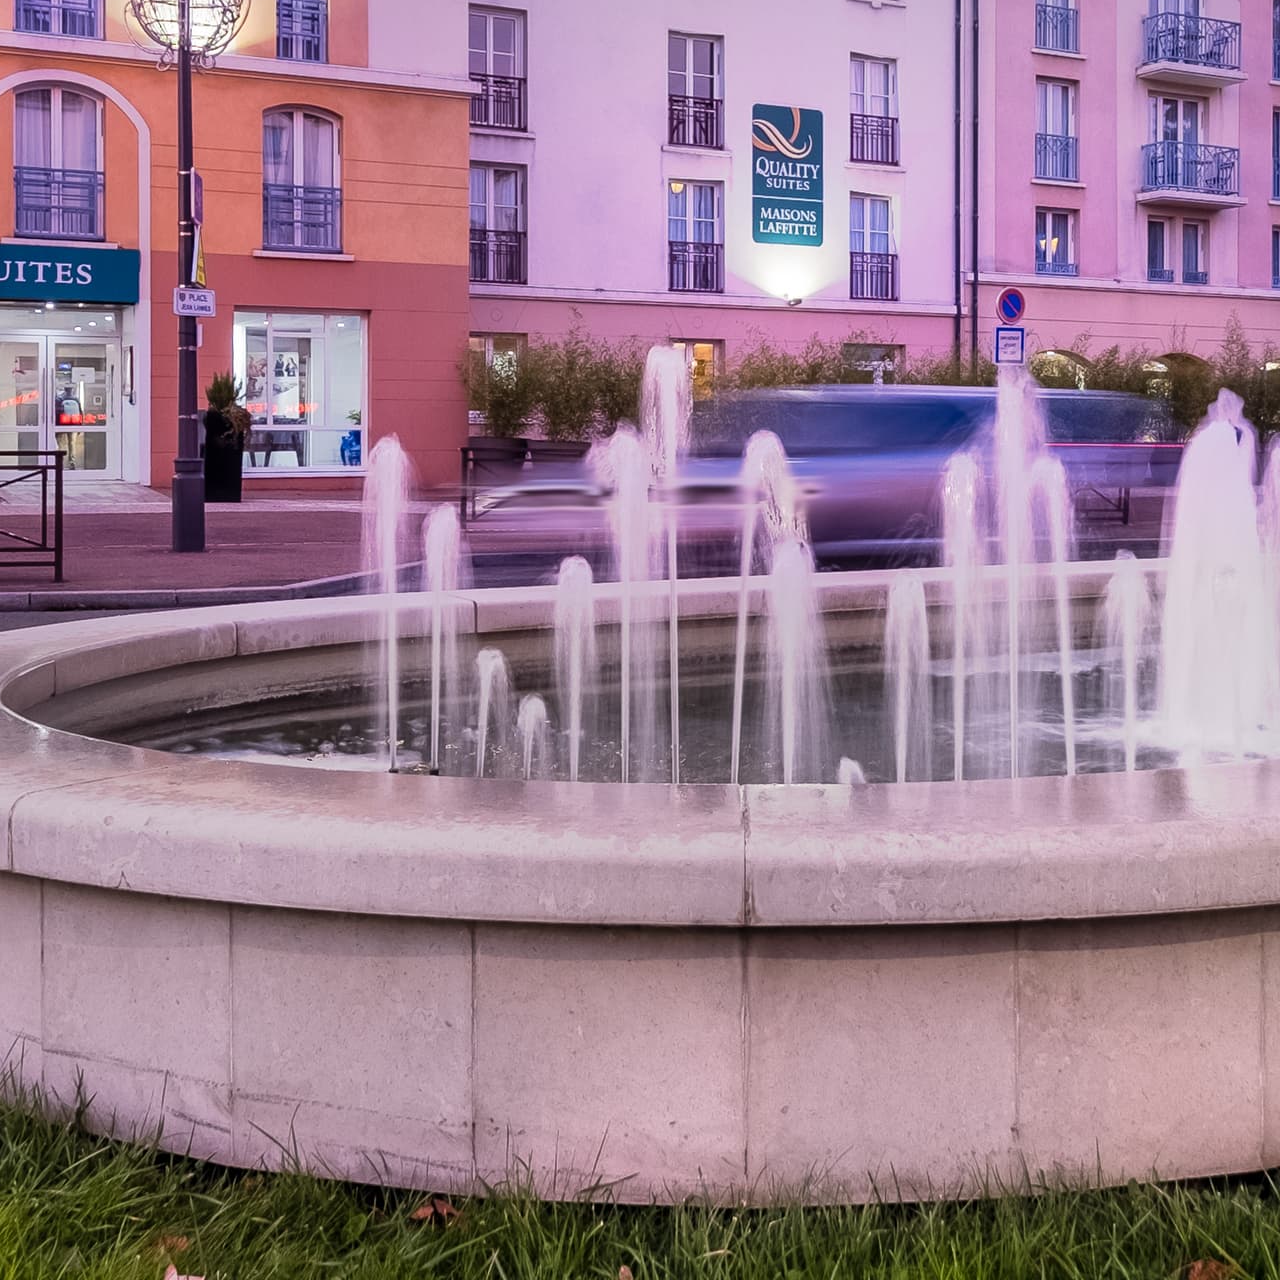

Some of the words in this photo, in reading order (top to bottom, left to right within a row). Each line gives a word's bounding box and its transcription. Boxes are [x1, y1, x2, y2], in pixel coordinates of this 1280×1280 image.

[756, 157, 819, 179] QUALITY
[766, 178, 810, 190] SUITES
[760, 207, 816, 222] MAISONS
[760, 221, 817, 236] LAFFITTE
[188, 293, 208, 302] PLACE
